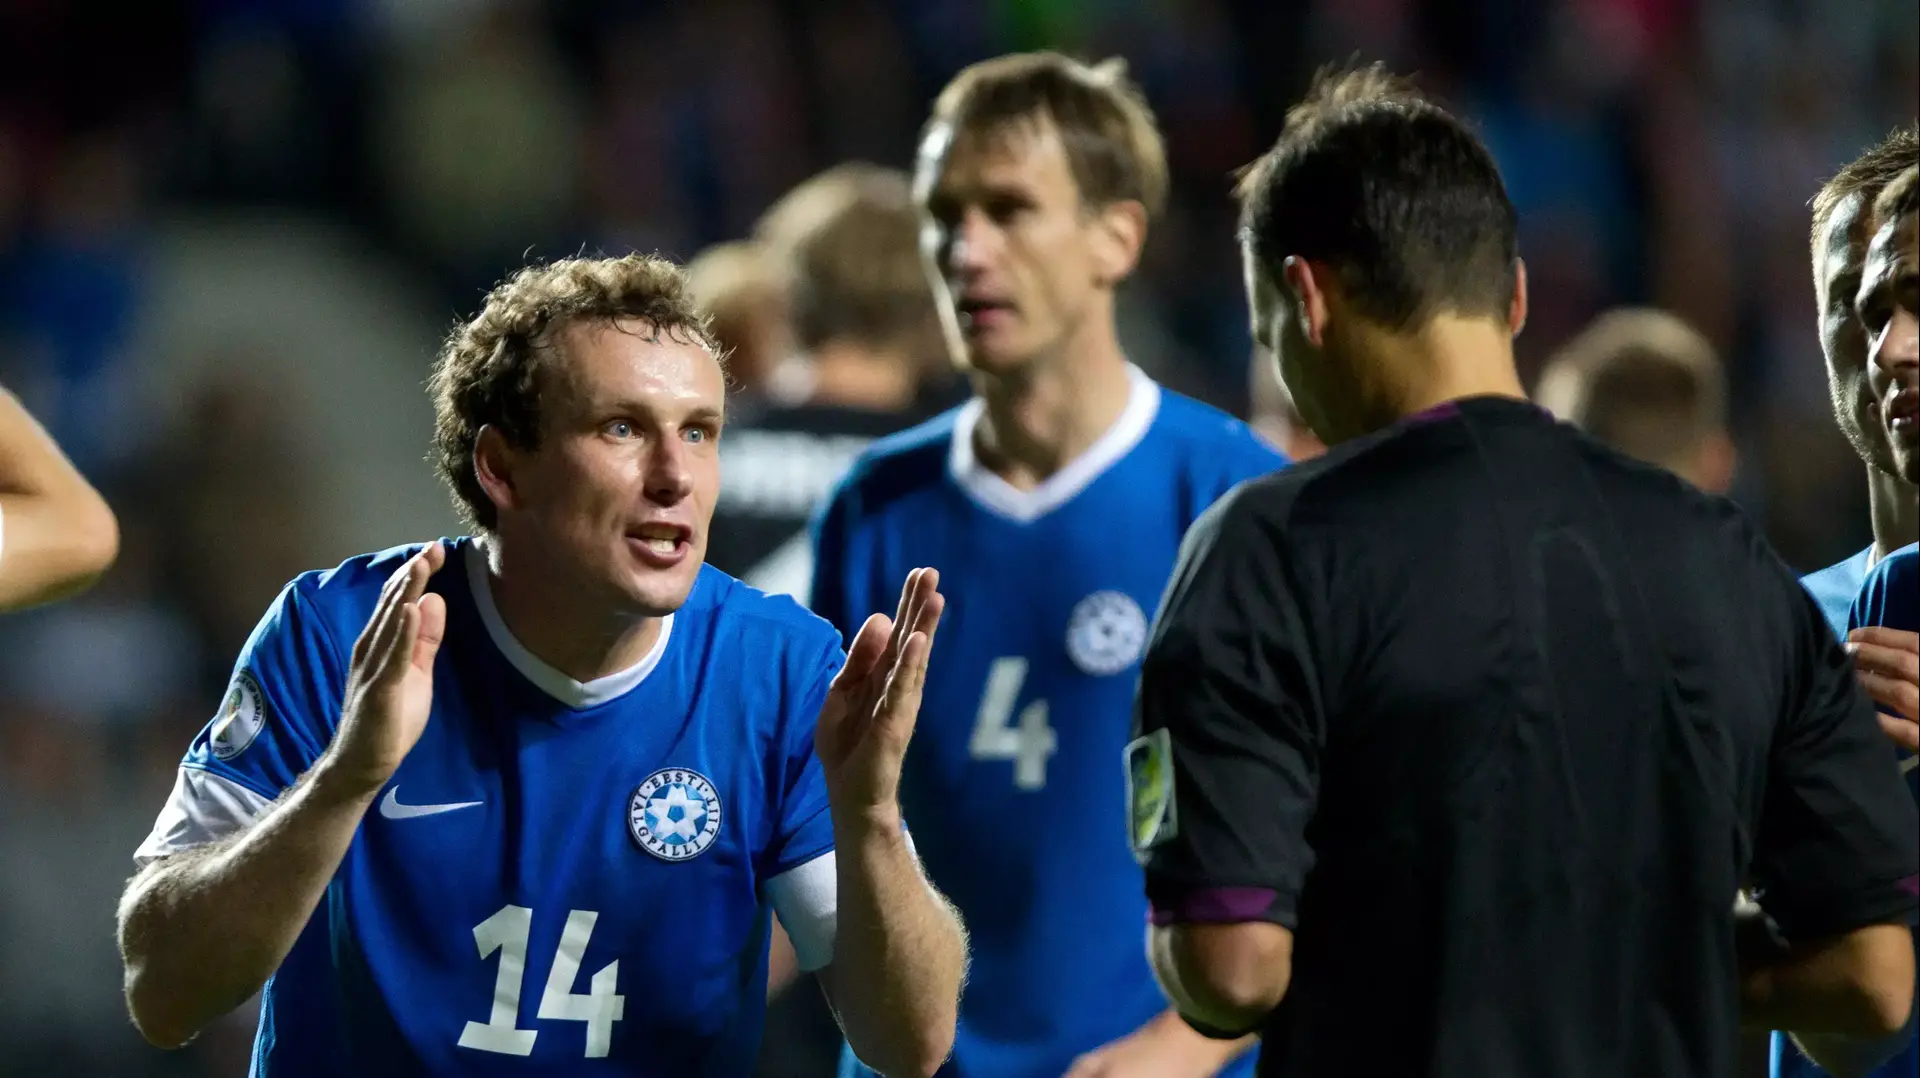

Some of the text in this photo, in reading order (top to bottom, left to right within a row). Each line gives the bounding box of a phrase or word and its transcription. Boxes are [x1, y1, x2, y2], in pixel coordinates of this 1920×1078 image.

[969, 656, 1058, 791] 4
[634, 791, 718, 855] JALGPALLI LIIT
[651, 773, 705, 790] EESTI
[457, 904, 625, 1058] 14
